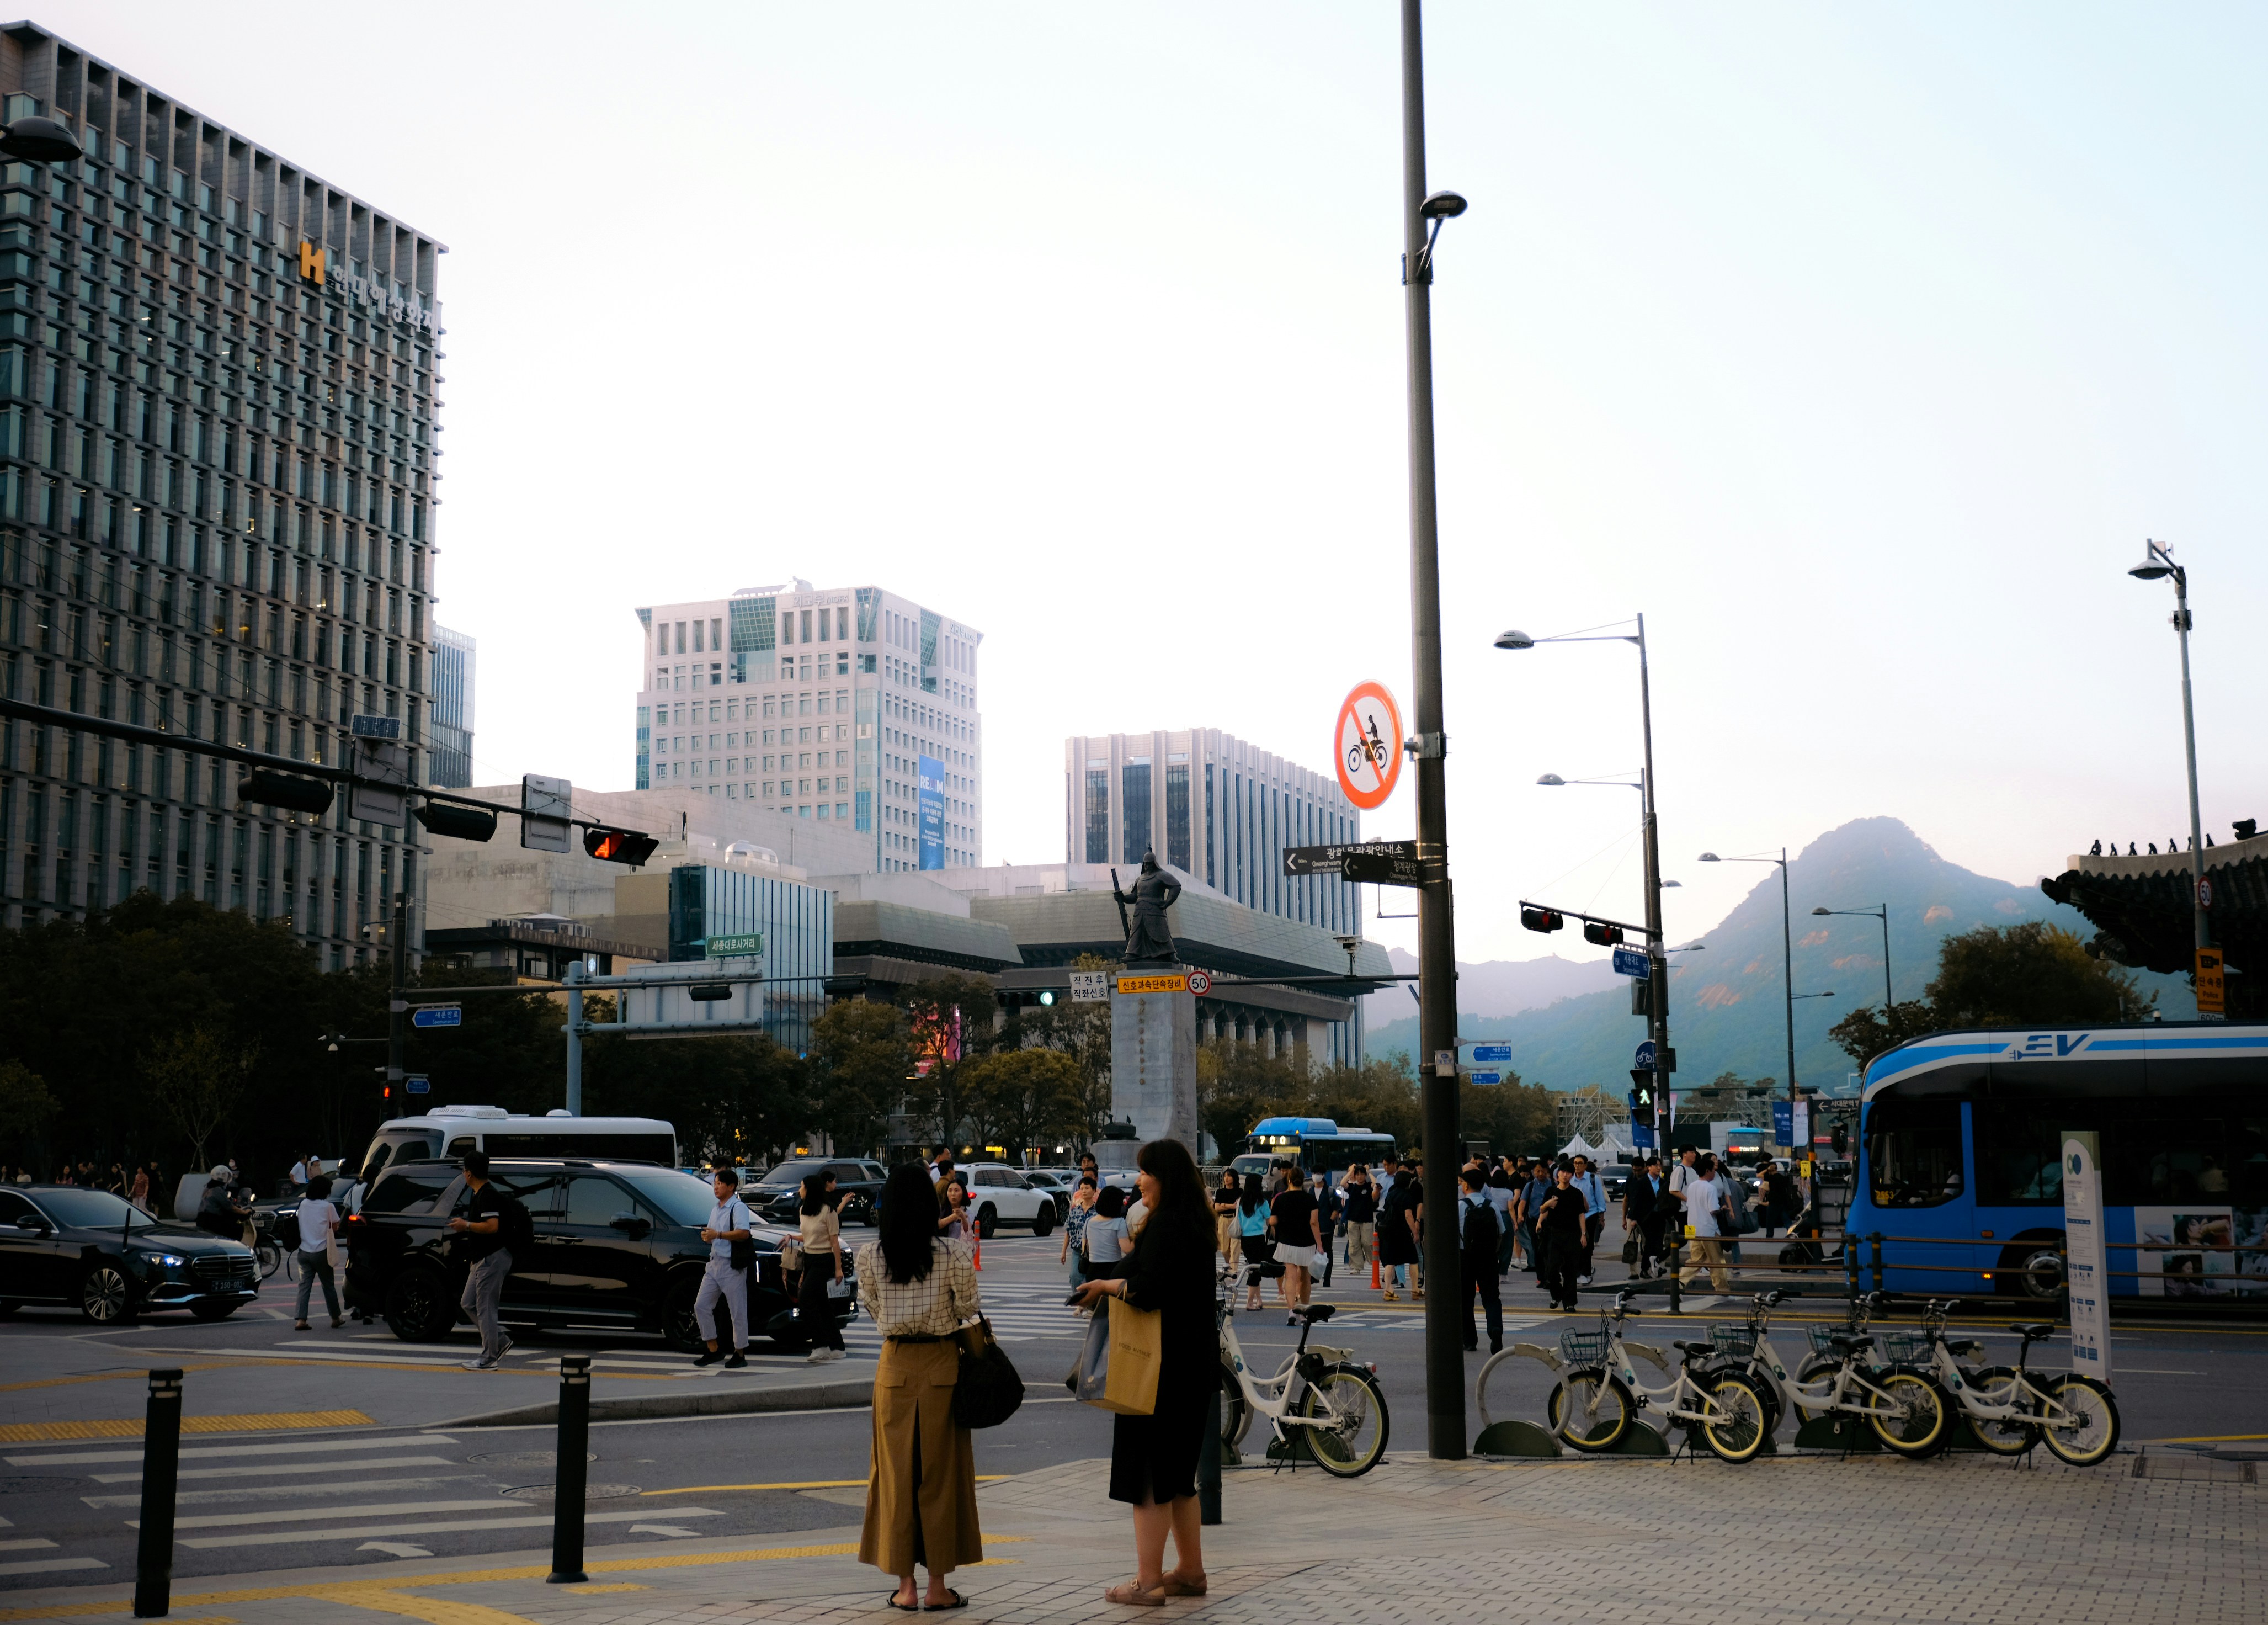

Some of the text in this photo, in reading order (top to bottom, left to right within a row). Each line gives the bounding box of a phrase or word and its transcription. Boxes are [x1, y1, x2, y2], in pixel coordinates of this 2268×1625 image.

[332, 264, 436, 341] 현대해상화재
[1393, 860, 1417, 874] 청계광장
[2201, 884, 2211, 902] 50
[712, 937, 755, 951] 세종대로사거리
[1122, 979, 1181, 991] 신호과속단속장비
[1192, 977, 1207, 990] 50
[1073, 987, 1106, 999] 직좌신호
[435, 1011, 459, 1019] 새문안로
[2015, 1034, 2090, 1058] EV
[1259, 1135, 1286, 1145] 700
